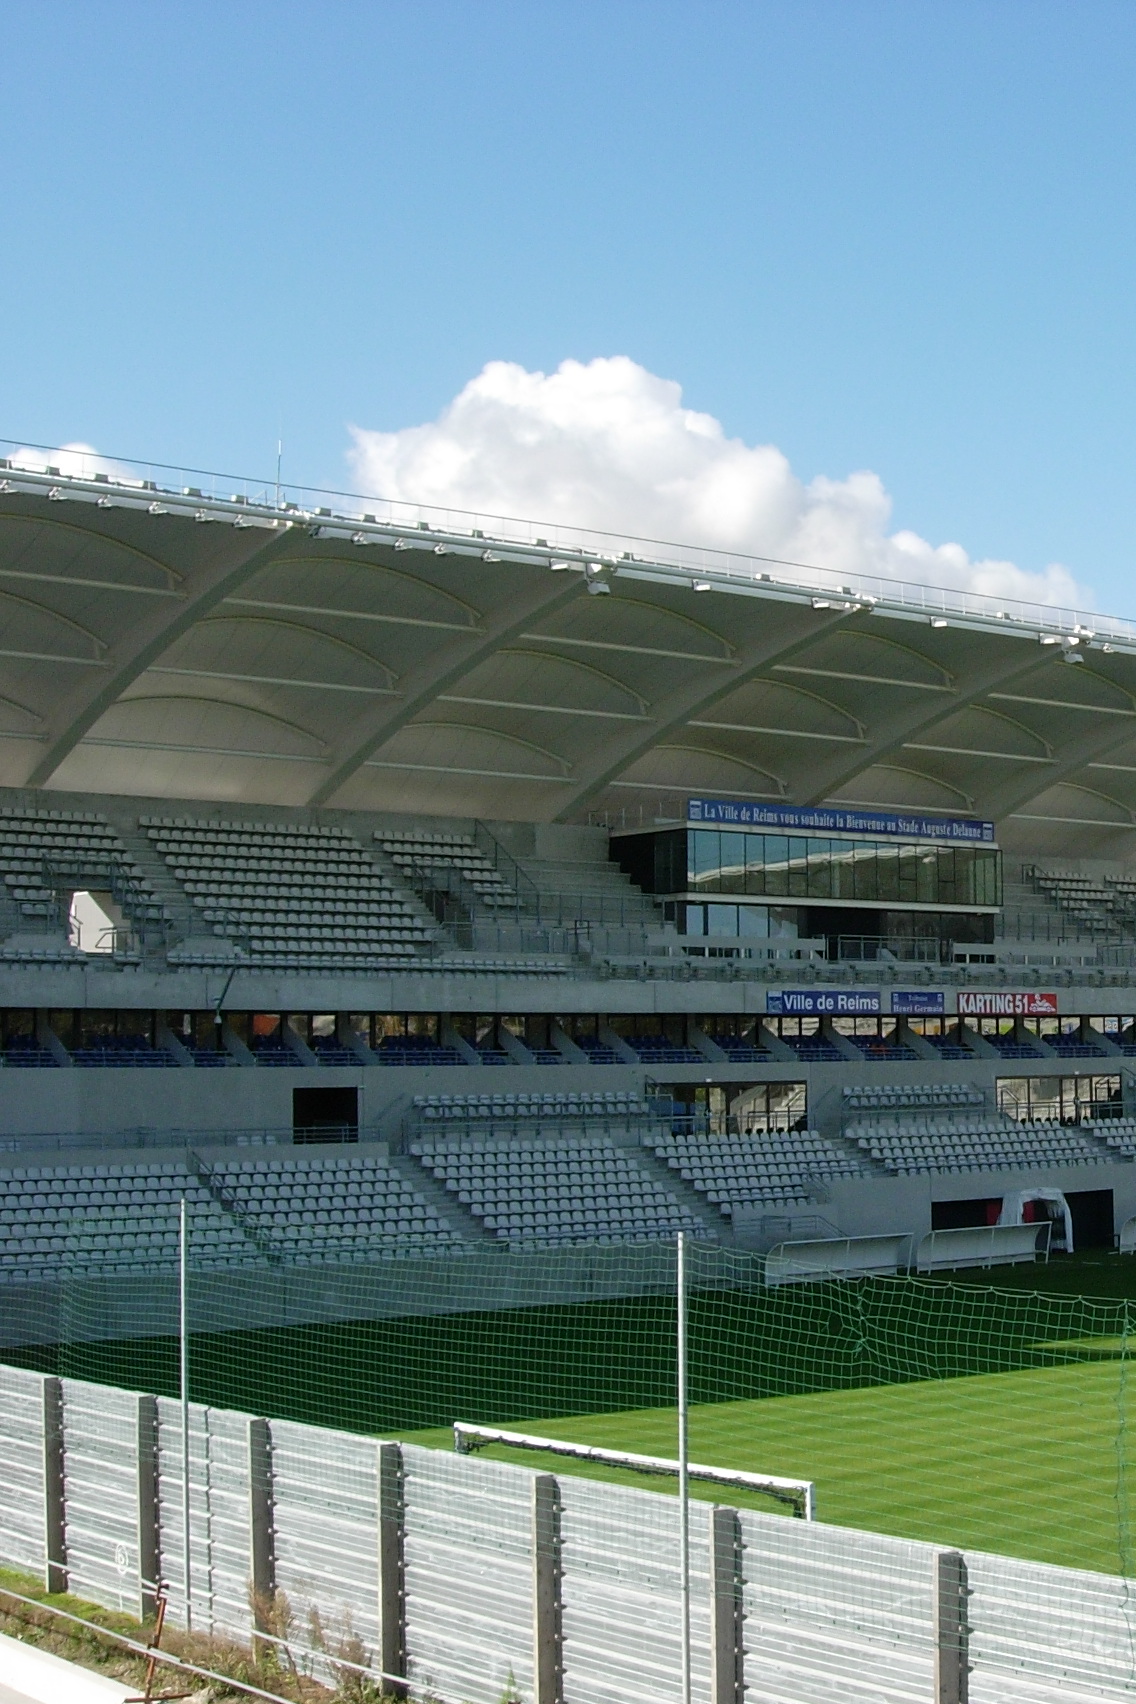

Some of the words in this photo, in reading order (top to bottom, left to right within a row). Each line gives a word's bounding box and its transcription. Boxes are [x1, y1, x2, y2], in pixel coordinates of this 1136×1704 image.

[704, 803, 716, 818] La
[718, 805, 738, 820] Ville
[740, 807, 750, 821] de
[753, 808, 777, 823] Reims
[780, 813, 799, 824] vous
[801, 813, 834, 828] souhaite
[836, 813, 844, 828] la
[846, 815, 885, 831] Bienvenue
[886, 821, 896, 832] au
[898, 819, 919, 833] Stade
[921, 821, 951, 838] Auguste
[952, 823, 982, 838] Delaune
[783, 994, 814, 1010] Ville
[817, 994, 834, 1010] de
[838, 994, 880, 1010] Reims
[959, 993, 1014, 1014] KARTING
[1015, 994, 1029, 1014] 51
